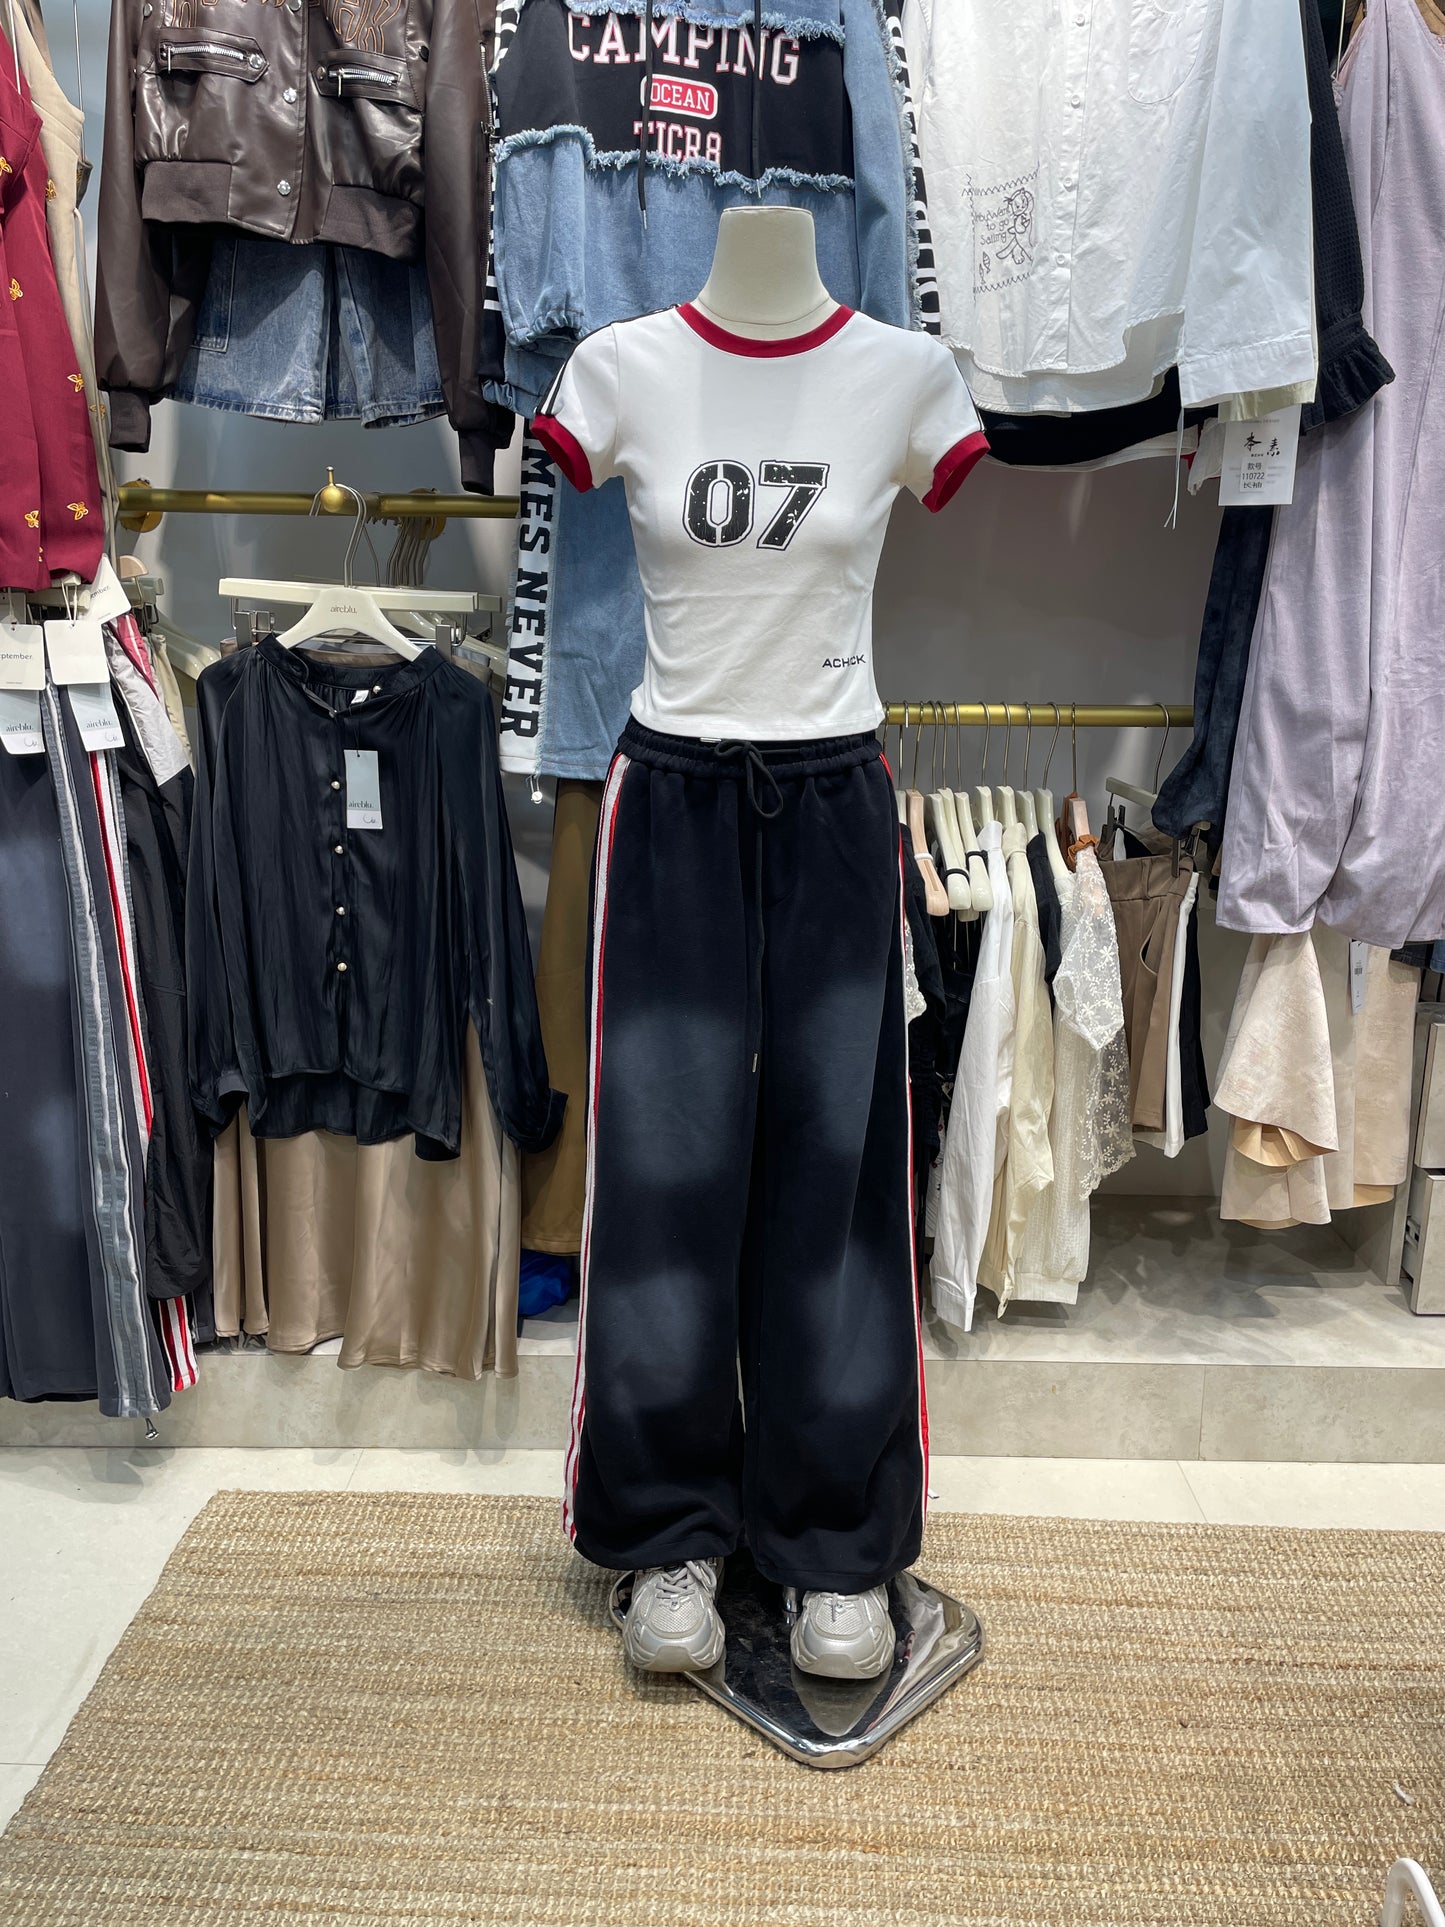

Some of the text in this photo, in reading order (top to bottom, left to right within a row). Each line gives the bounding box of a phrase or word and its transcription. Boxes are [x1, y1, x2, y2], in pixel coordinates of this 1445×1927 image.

[567, 10, 800, 85] CAMPING
[650, 81, 711, 112] OCEAN
[682, 459, 830, 551] 07
[1242, 472, 1265, 480] 110722
[500, 567, 548, 738] NEVER
